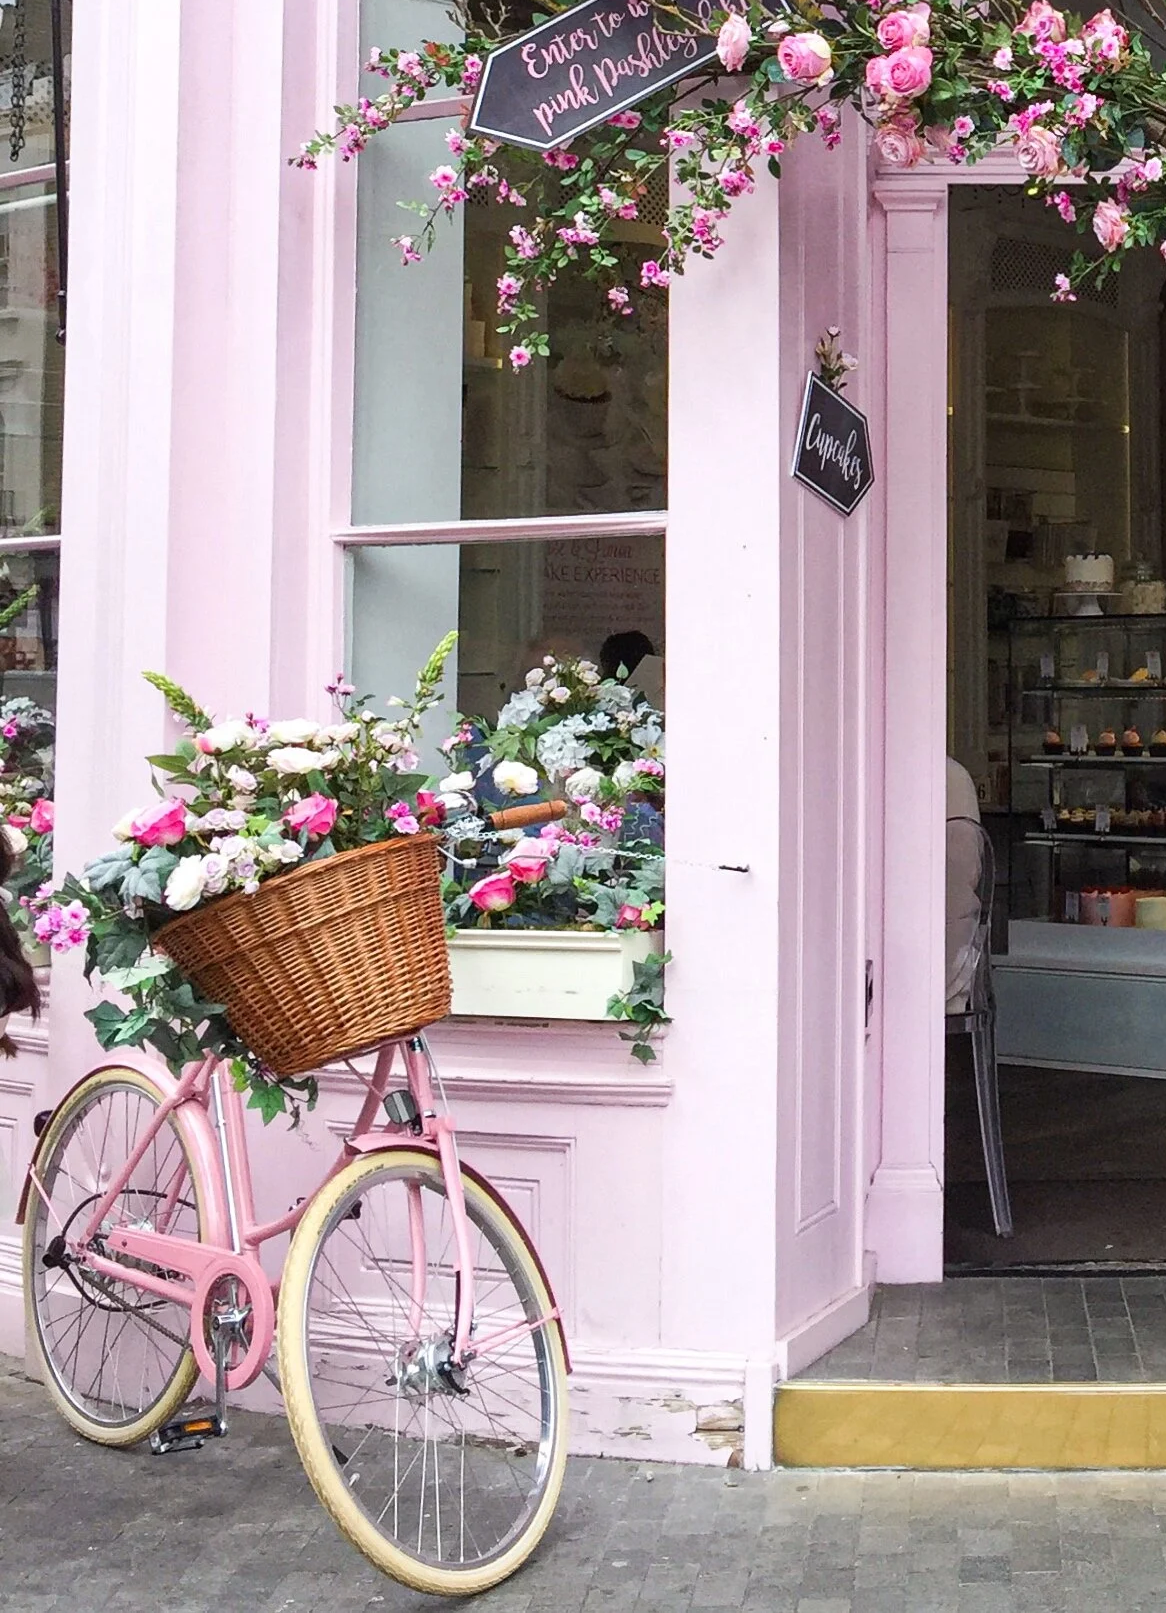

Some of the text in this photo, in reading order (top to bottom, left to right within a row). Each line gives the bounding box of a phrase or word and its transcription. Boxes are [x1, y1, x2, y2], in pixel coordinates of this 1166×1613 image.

[521, 10, 626, 79] Enter to
[532, 63, 600, 137] pink
[805, 412, 864, 490] Cupcakes
[543, 563, 661, 585] AKE EXPERIENCE
